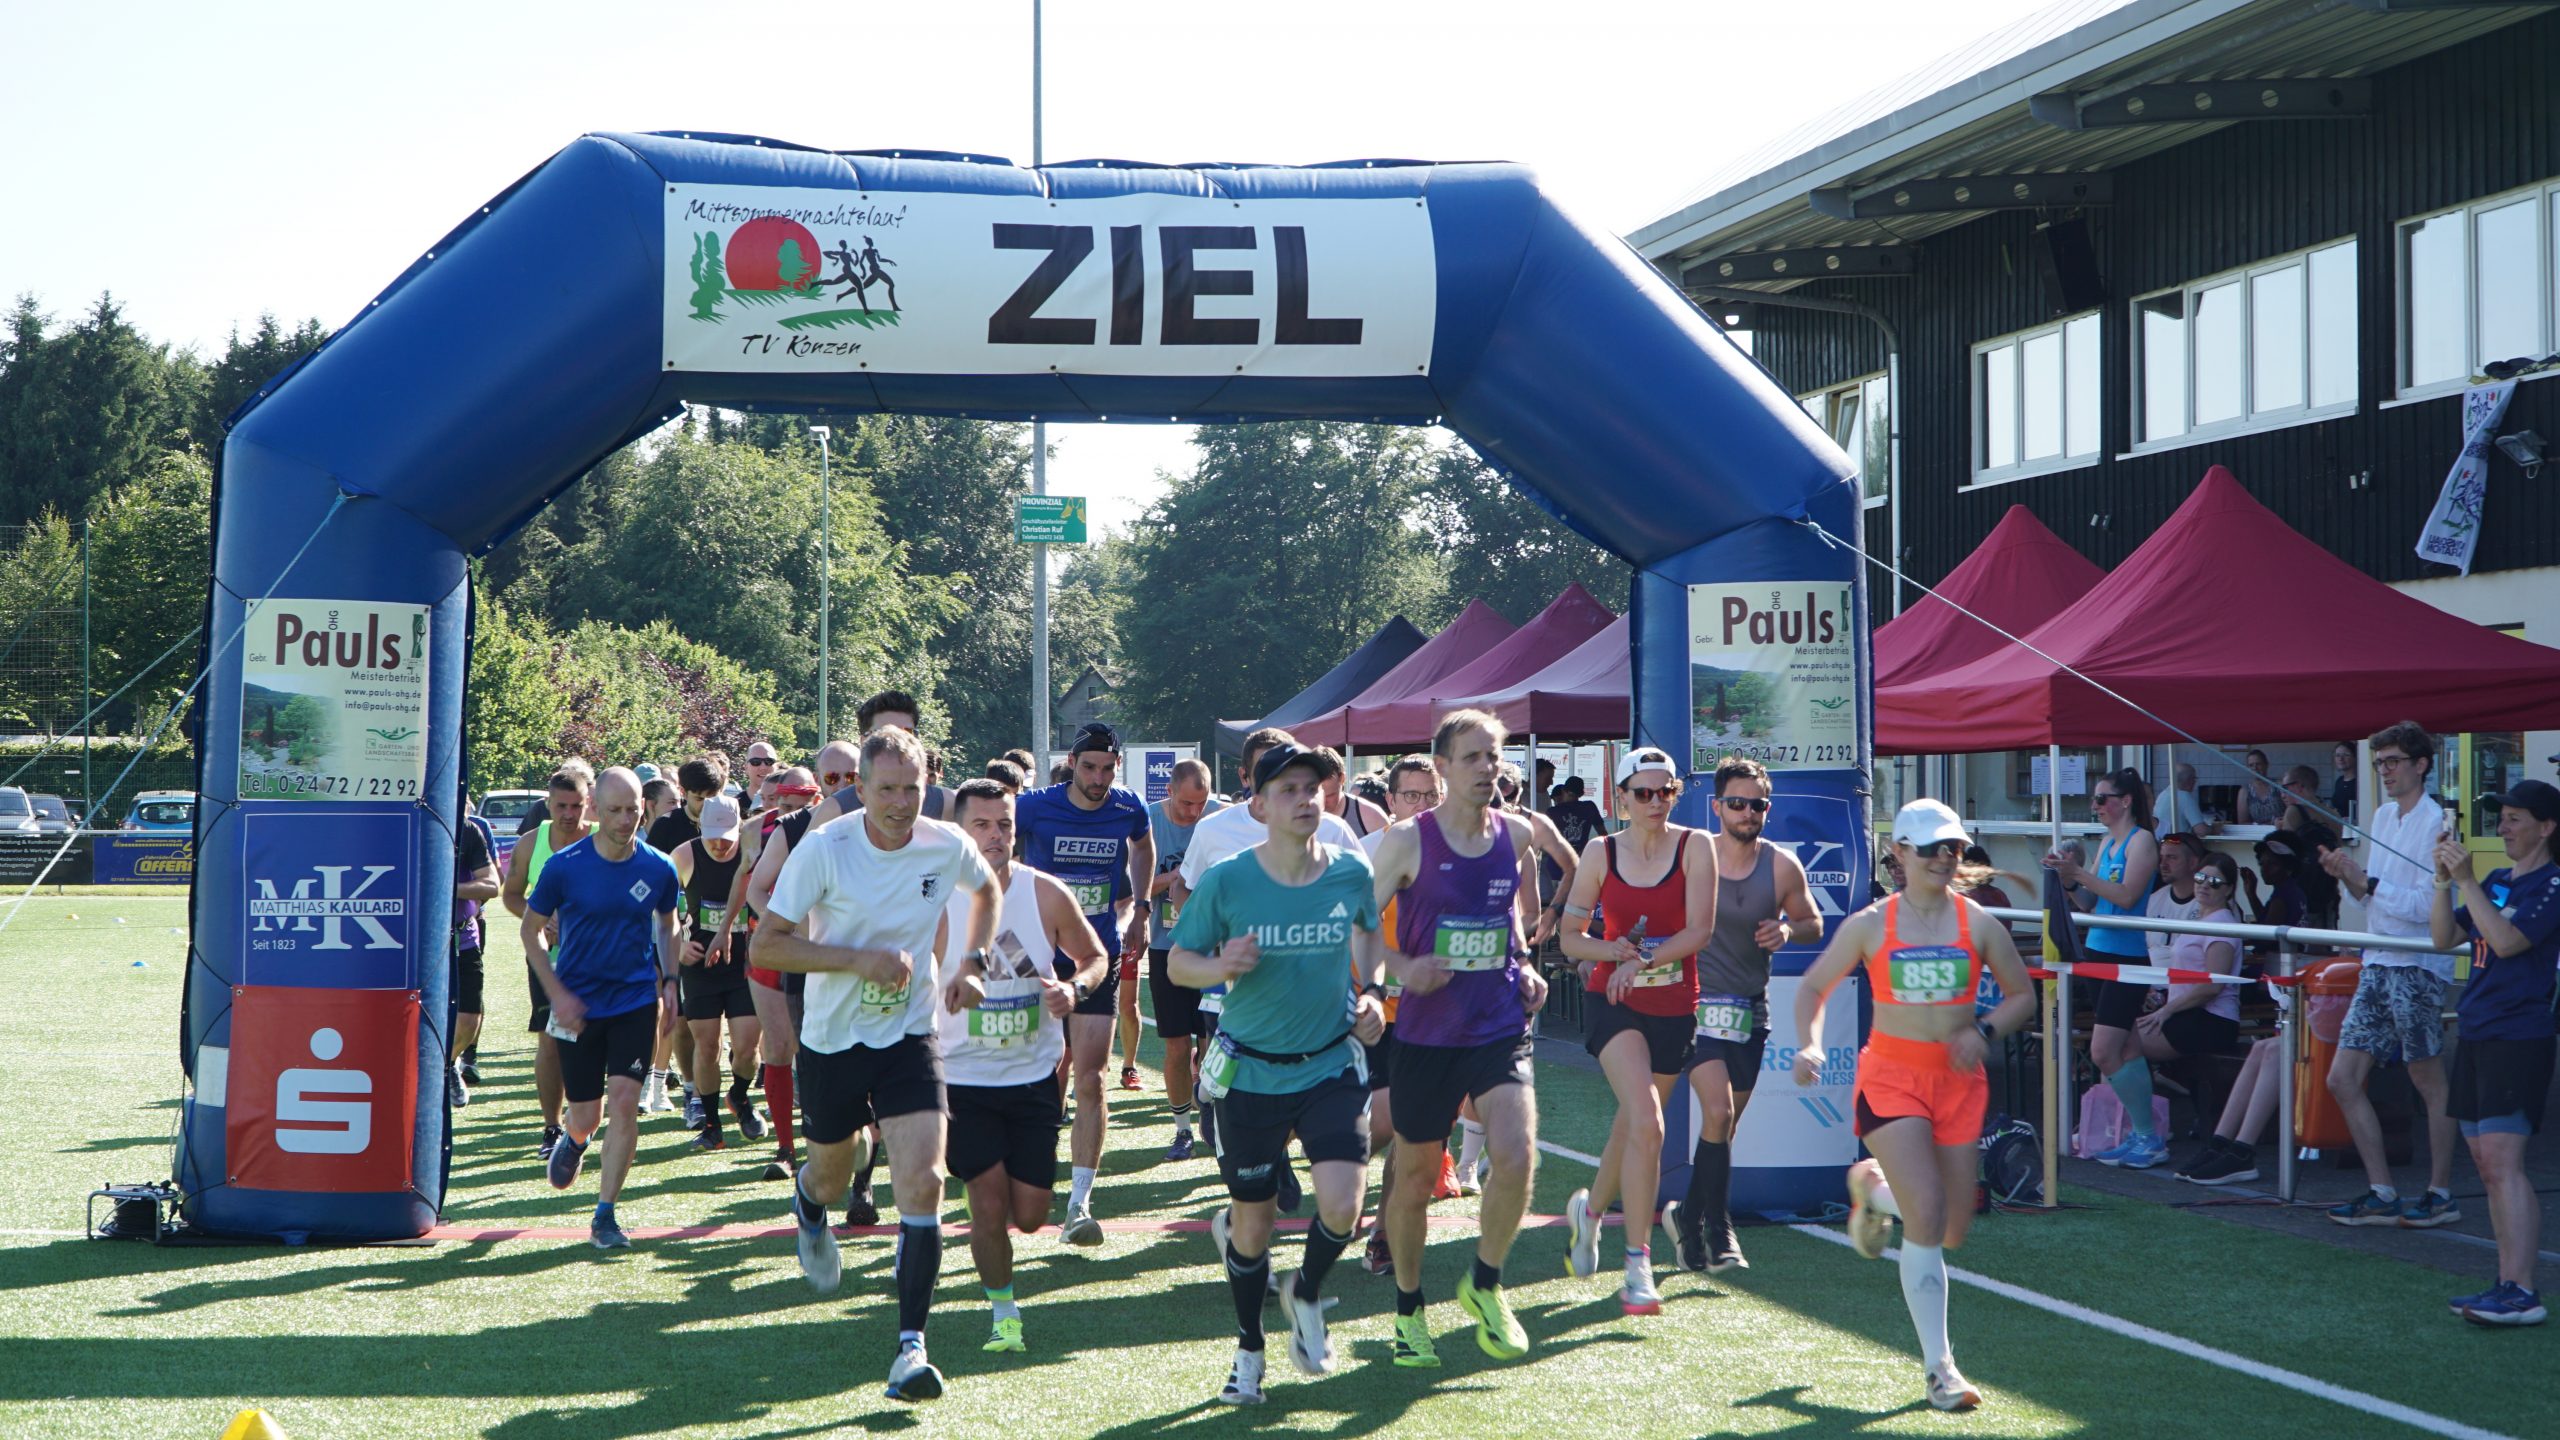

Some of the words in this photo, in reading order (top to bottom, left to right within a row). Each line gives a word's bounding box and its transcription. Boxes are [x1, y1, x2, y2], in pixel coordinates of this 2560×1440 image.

[685, 199, 907, 229] Mittsommernachtslauf
[988, 223, 1364, 346] ZIEL
[742, 334, 779, 355] TV
[786, 334, 862, 358] Konzen
[1022, 498, 1063, 506] PROVINZIAL
[1771, 590, 1781, 610] OHG
[328, 610, 339, 631] OHG
[1695, 634, 1714, 644] Gebr.
[1722, 592, 1834, 646] Pauls
[249, 652, 267, 662] Gebr.
[275, 613, 402, 670] Pauls
[1795, 645, 1850, 655] Meisterbetrieb
[1790, 661, 1850, 670] www.pauls-ohg.de
[350, 670, 421, 683] Meisterbetrieb
[1791, 674, 1850, 683] info@pauls-ohg.de
[344, 688, 421, 699] www.pauls-ohg.de
[345, 701, 421, 713] info@pauls-ohg.de
[1816, 745, 1833, 761] 22
[1838, 745, 1852, 761] 92
[243, 774, 272, 793] Tel.
[296, 775, 319, 795] 24
[327, 777, 349, 795] 72
[369, 777, 391, 796] 22
[397, 778, 416, 797] 92
[1057, 840, 1117, 854] PETERS
[1806, 874, 1847, 885] ULARD
[253, 901, 325, 914] MATTHIAS
[329, 901, 402, 914] KAULARD
[253, 940, 269, 950] Seit
[272, 939, 296, 950] 1823
[1247, 922, 1345, 947] HILGERS
[1448, 931, 1498, 956] 868
[1902, 961, 1956, 989] 853
[981, 1009, 1029, 1036] 869
[1704, 1006, 1745, 1029] 867
